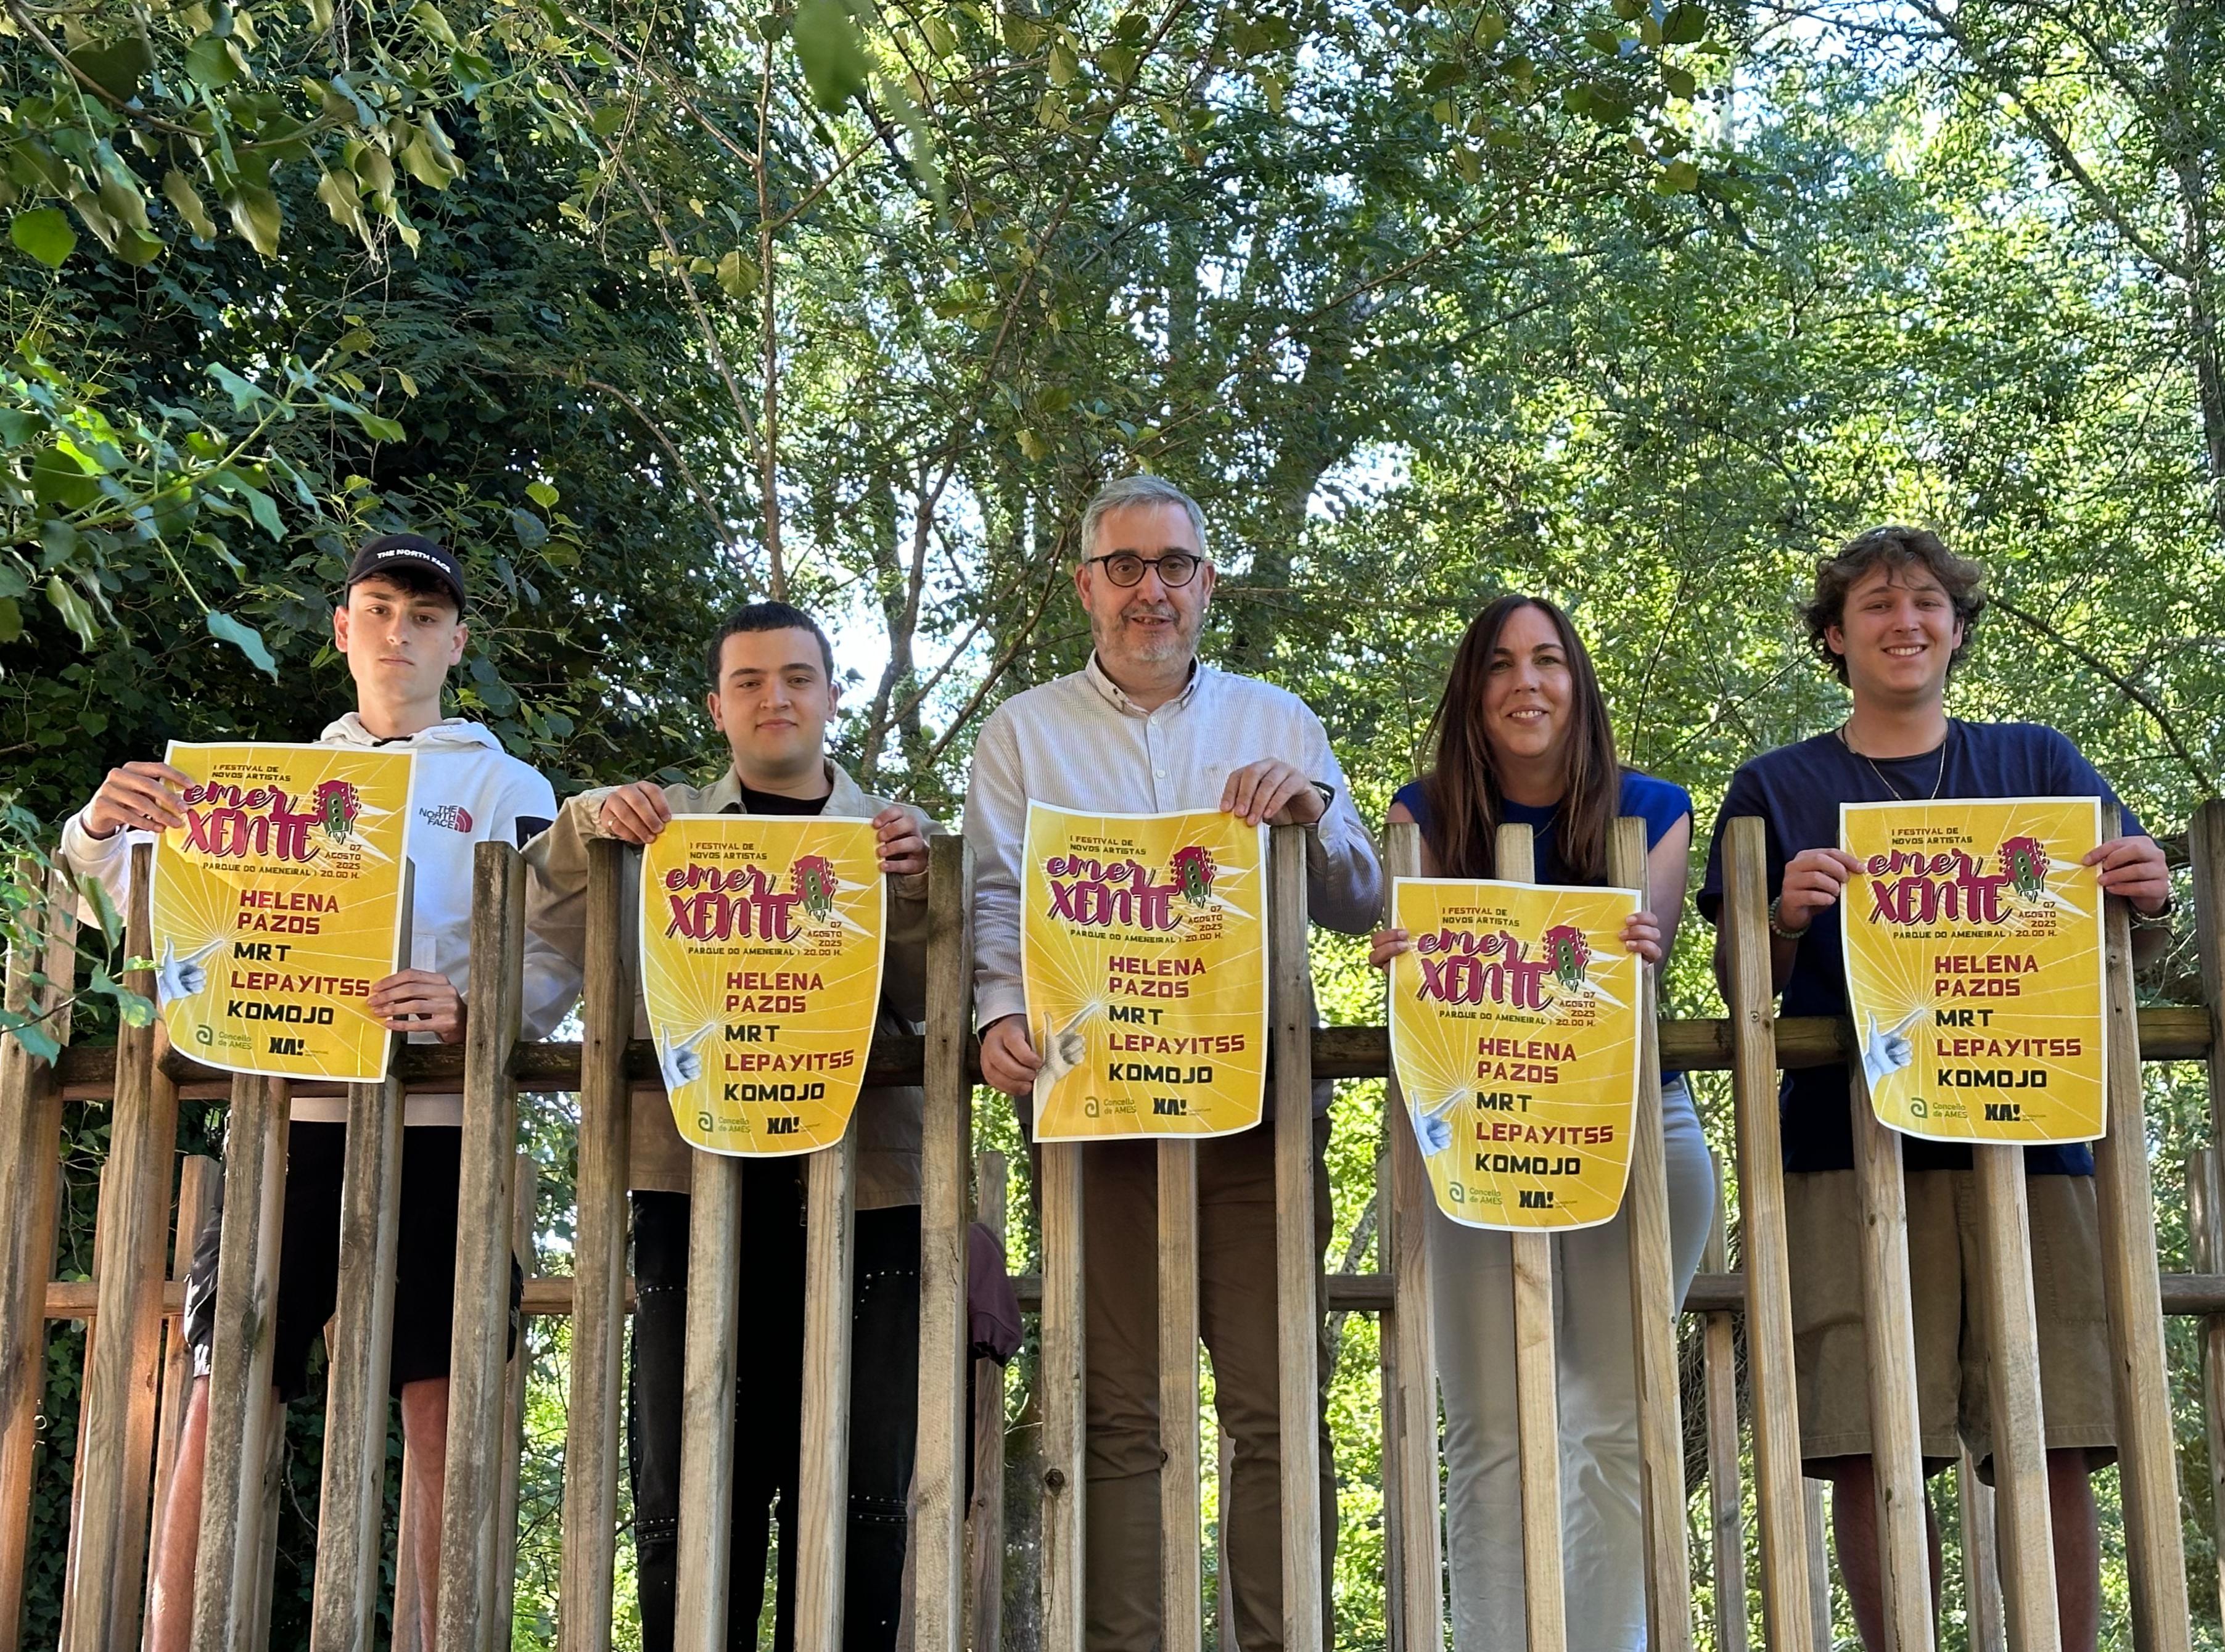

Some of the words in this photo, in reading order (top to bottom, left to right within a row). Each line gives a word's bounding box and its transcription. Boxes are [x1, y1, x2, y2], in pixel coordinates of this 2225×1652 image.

[377, 550, 395, 559] THE
[397, 549, 430, 560] NORTH
[419, 808, 456, 821] NORTH
[427, 818, 454, 829] FACE
[696, 842, 739, 850] FESTIVAL
[1071, 844, 1100, 852] NOVOS
[1103, 847, 1146, 855] ARTISTAS
[1076, 836, 1118, 845] FESTIVAL
[203, 863, 240, 871] PARQUE
[259, 867, 311, 876] AMENEIRAL
[321, 870, 348, 878] 20.00
[239, 889, 339, 913] HELENA
[1211, 905, 1222, 913] 07
[237, 912, 320, 935] PAZOS
[1188, 914, 1223, 923] AGOSTO
[1476, 917, 1520, 927] ARTISTAS
[1071, 929, 1106, 939] PARQUE
[1125, 935, 1175, 943] AMENEIRAL
[1185, 934, 1212, 942] 20.00
[234, 942, 291, 962] MRT
[1109, 955, 1206, 976] HELENA
[1935, 955, 2039, 973] HELENA
[231, 970, 370, 997] LEPAYITSS
[726, 972, 825, 991] HELENA
[1110, 977, 1189, 998] PAZOS
[1935, 978, 2020, 997] PAZOS
[227, 1000, 334, 1025] KOMOJO
[726, 995, 806, 1013] PAZOS
[1109, 1005, 1163, 1025] MRT
[1439, 1011, 1476, 1019] PARQUE
[1495, 1014, 1546, 1024] AMENEIRAL
[1936, 1009, 1993, 1027] MRT
[219, 1032, 252, 1042] Concello
[725, 1025, 780, 1042] MRT
[1110, 1033, 1244, 1054] LEPAYITSS
[1478, 1037, 1576, 1061] HELENA
[1937, 1038, 2081, 1056] LEPAYITSS
[725, 1049, 853, 1072] LEPAYITSS
[1109, 1062, 1213, 1083] KOMOJO
[1478, 1061, 1558, 1083] PAZOS
[1938, 1069, 2047, 1088] KOMOJO
[723, 1083, 825, 1101] KOMOJO
[1114, 1106, 1137, 1114] AMES
[1476, 1091, 1532, 1112] MRT
[1933, 1102, 1966, 1110] Concello
[718, 1117, 749, 1125] Concello
[1476, 1122, 1613, 1144] LEPAYITSS
[1476, 1153, 1581, 1175] KOMOJO
[1470, 1188, 1500, 1196] Concello
